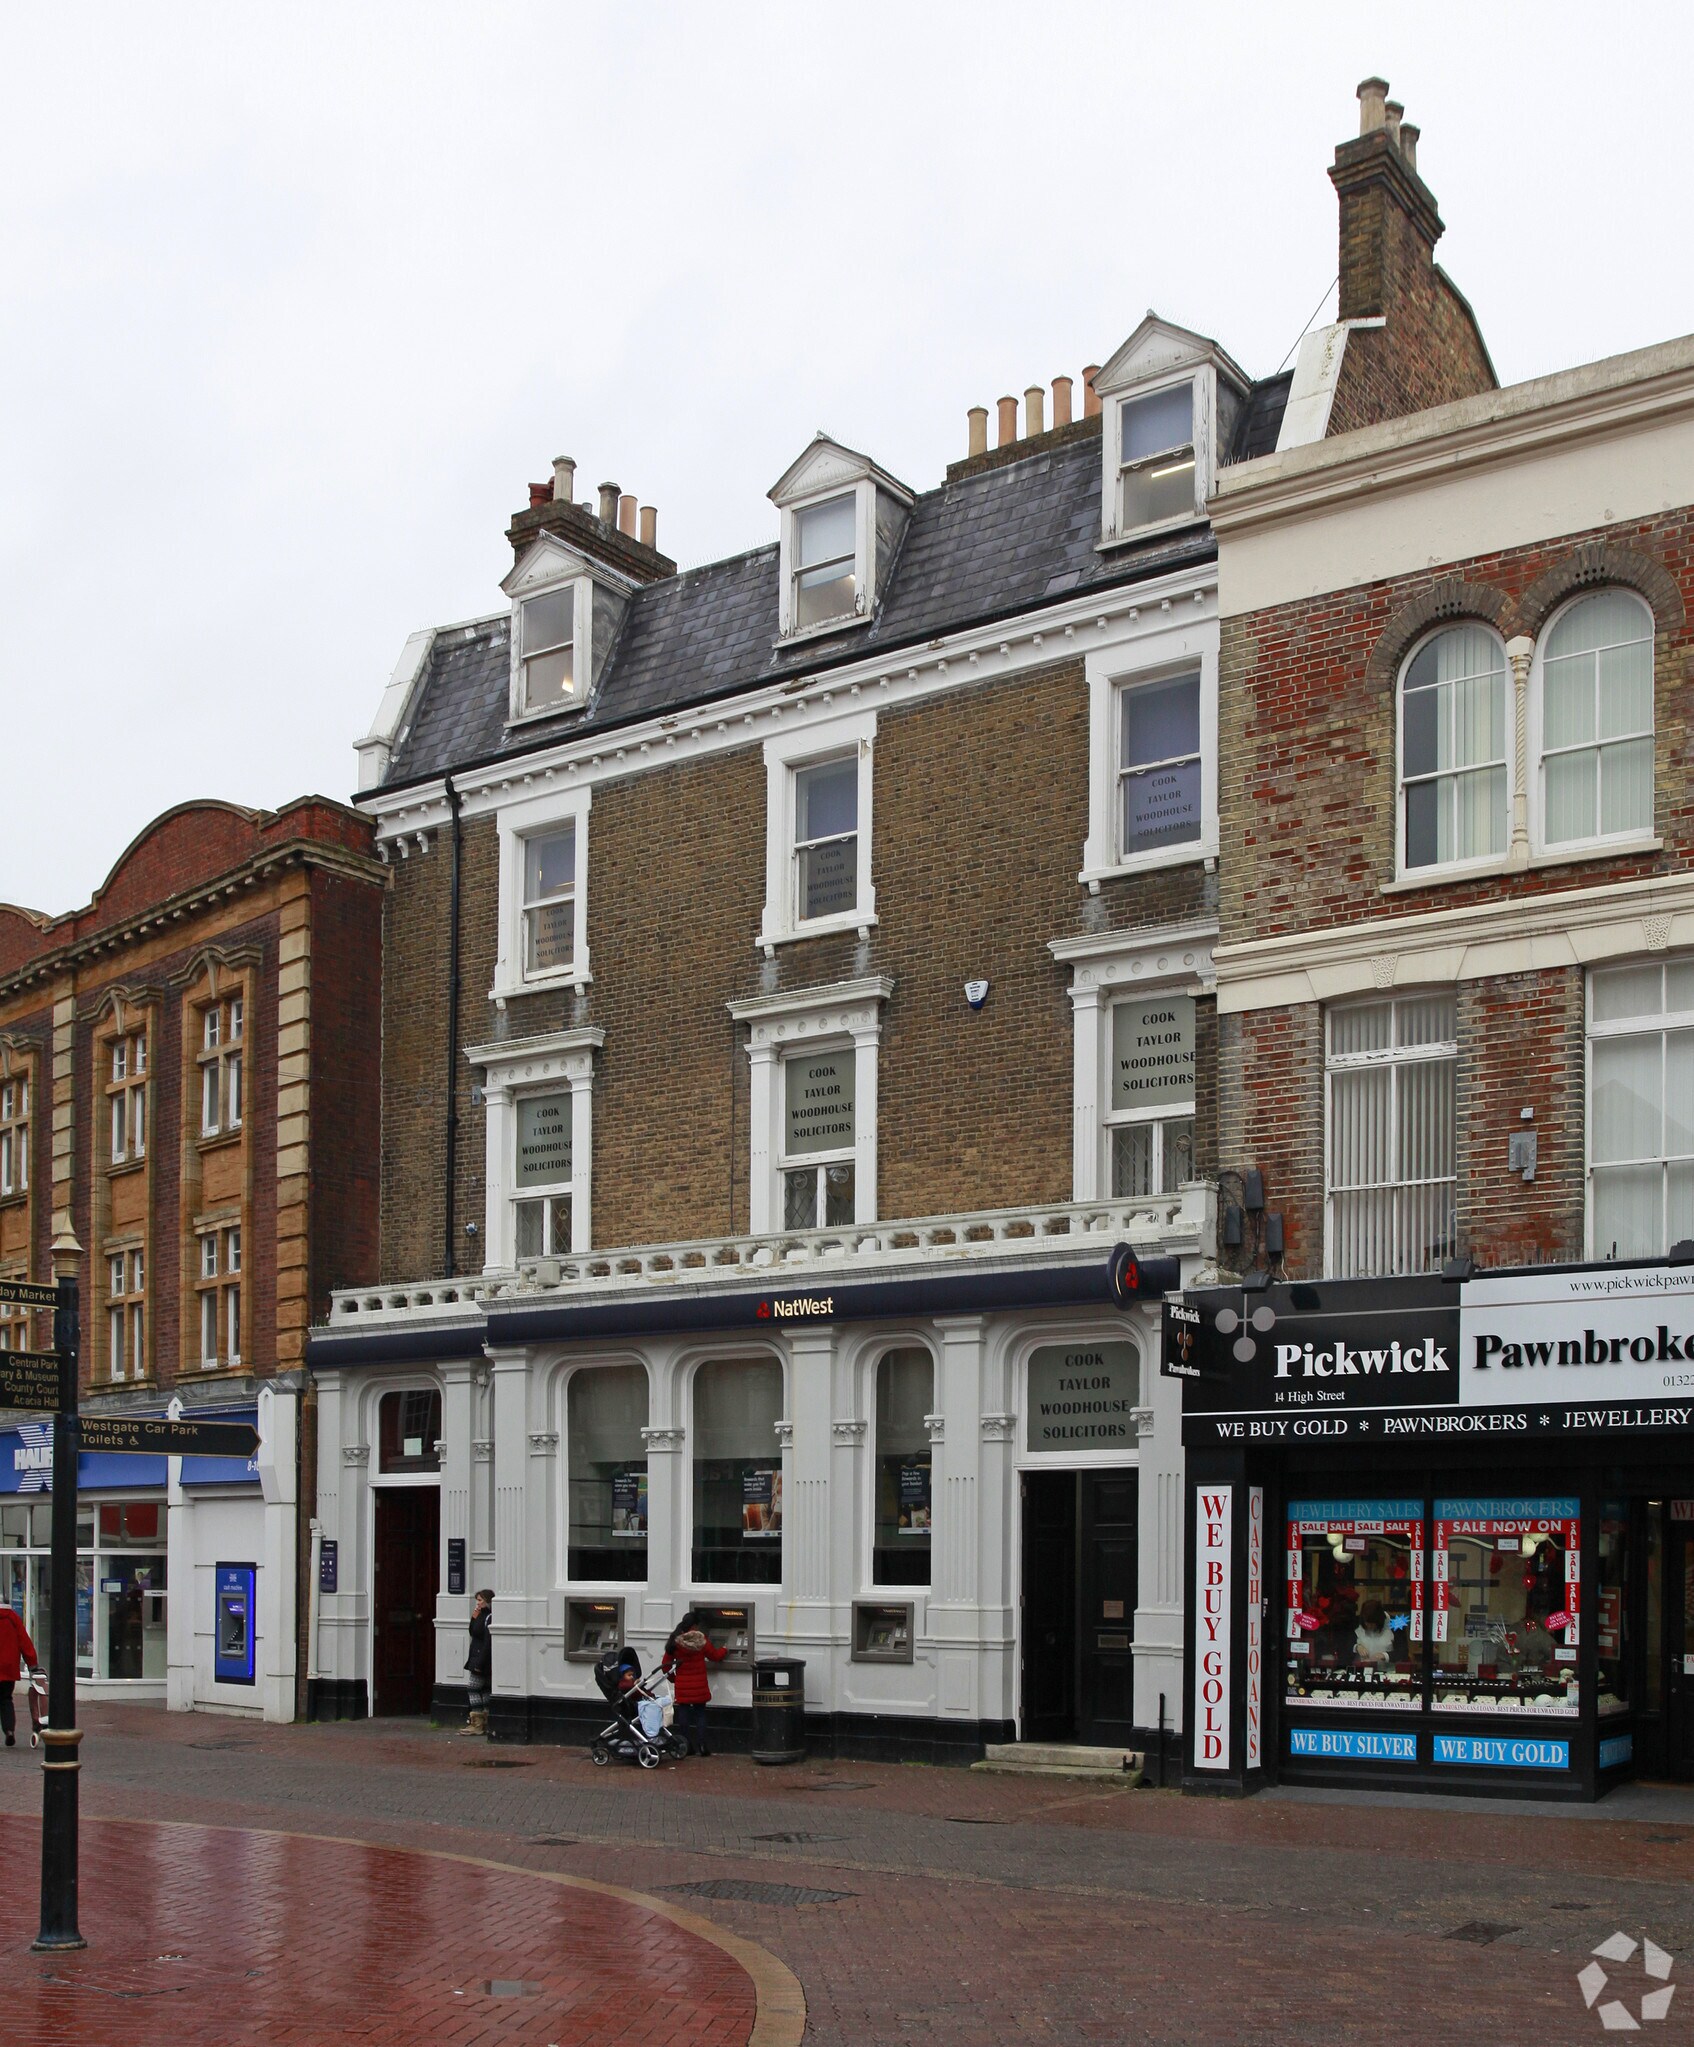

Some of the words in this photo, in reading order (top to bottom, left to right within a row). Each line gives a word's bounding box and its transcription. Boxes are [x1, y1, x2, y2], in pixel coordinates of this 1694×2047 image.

[1151, 775, 1177, 788] COOK
[1148, 790, 1182, 804] TAYLOR
[1135, 803, 1193, 822] WOODHOUSE
[1138, 820, 1191, 837] SOLICITORS
[1142, 1011, 1175, 1026] COOK
[1136, 1031, 1181, 1047] TAYLOR
[1121, 1051, 1196, 1070] WOODHOUSE
[809, 1066, 836, 1079] COOK
[1123, 1073, 1194, 1091] SOLICITORS
[804, 1084, 840, 1099] TAYLOR
[536, 1107, 559, 1118] COOK
[792, 1102, 853, 1120] WOODHOUSE
[532, 1124, 563, 1137] TAYLOR
[793, 1121, 851, 1138] SOLICITORS
[523, 1158, 572, 1173] SOLICITORS
[19, 1288, 56, 1301] Market
[773, 1297, 834, 1318] NatWest
[1169, 1305, 1200, 1323] Pickwick
[9, 1355, 39, 1369] Central
[40, 1359, 58, 1370] Park
[1065, 1353, 1104, 1367] COOK
[1273, 1338, 1450, 1379] Pickwick
[16, 1369, 23, 1380] &
[25, 1370, 59, 1382] Museum
[1058, 1376, 1111, 1391] TAYLOR
[4, 1381, 34, 1395] County
[36, 1383, 59, 1395] Court
[13, 1394, 42, 1406] Acacia
[43, 1396, 59, 1407] Hall
[1274, 1392, 1285, 1403] 14
[1287, 1391, 1314, 1405] High
[1316, 1389, 1345, 1402] Street
[1040, 1400, 1129, 1415] WOODHOUSE
[81, 1420, 140, 1435] Westgate
[145, 1423, 166, 1434] Car
[171, 1424, 198, 1436] Park
[1216, 1422, 1245, 1438] WE
[1248, 1421, 1290, 1437] BUY
[1293, 1419, 1348, 1436] GOLD
[1383, 1413, 1528, 1434] PAWNBROKERS
[1562, 1407, 1693, 1428] JEWELLERY
[1043, 1424, 1126, 1439] SOLICITORS
[81, 1434, 124, 1446] Toilets
[1294, 1503, 1374, 1518] JEWELLERY
[1378, 1502, 1421, 1518] SALES
[1442, 1501, 1574, 1517] PAWNBROKERS
[1201, 1494, 1228, 1548] WE
[1302, 1523, 1325, 1531] SALE
[1330, 1523, 1353, 1531] SALE
[1357, 1523, 1381, 1531] SALE
[1386, 1522, 1410, 1531] SALE
[1452, 1521, 1487, 1533] SALE
[1492, 1521, 1532, 1533] NOW
[1537, 1520, 1562, 1532] ON
[1249, 1494, 1261, 1605] CASH
[1203, 1561, 1224, 1642] BUY
[1248, 1621, 1259, 1760] LOANS
[1202, 1650, 1223, 1760] GOLD
[1293, 1732, 1317, 1752] WE
[1322, 1734, 1353, 1753] BUY
[1357, 1736, 1415, 1757] SILVER
[1440, 1739, 1467, 1759] WE
[1472, 1741, 1507, 1761] BUY
[1512, 1743, 1564, 1764] GOLD
